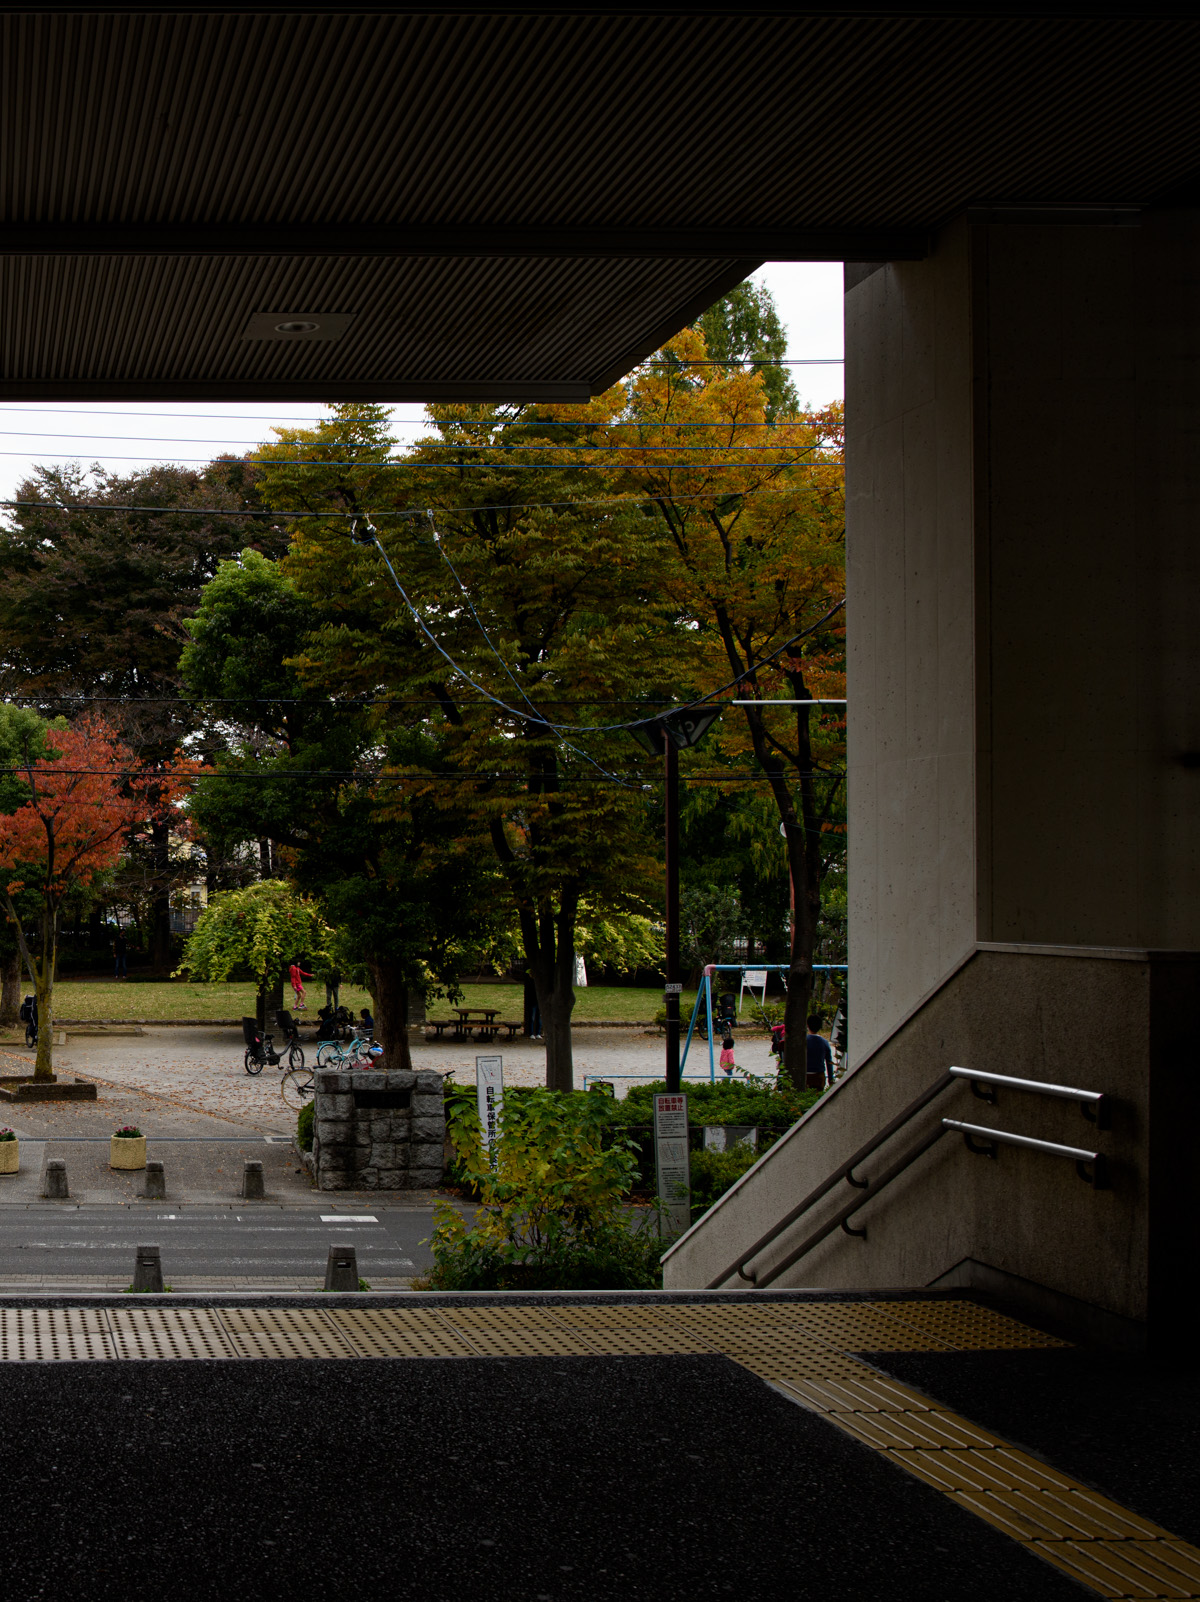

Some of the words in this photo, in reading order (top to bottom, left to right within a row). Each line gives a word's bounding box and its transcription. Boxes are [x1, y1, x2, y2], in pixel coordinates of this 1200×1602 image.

[658, 1096, 684, 1104] 自転車等
[658, 1104, 684, 1112] 放置禁止
[486, 1086, 498, 1172] 自転車保管所の
